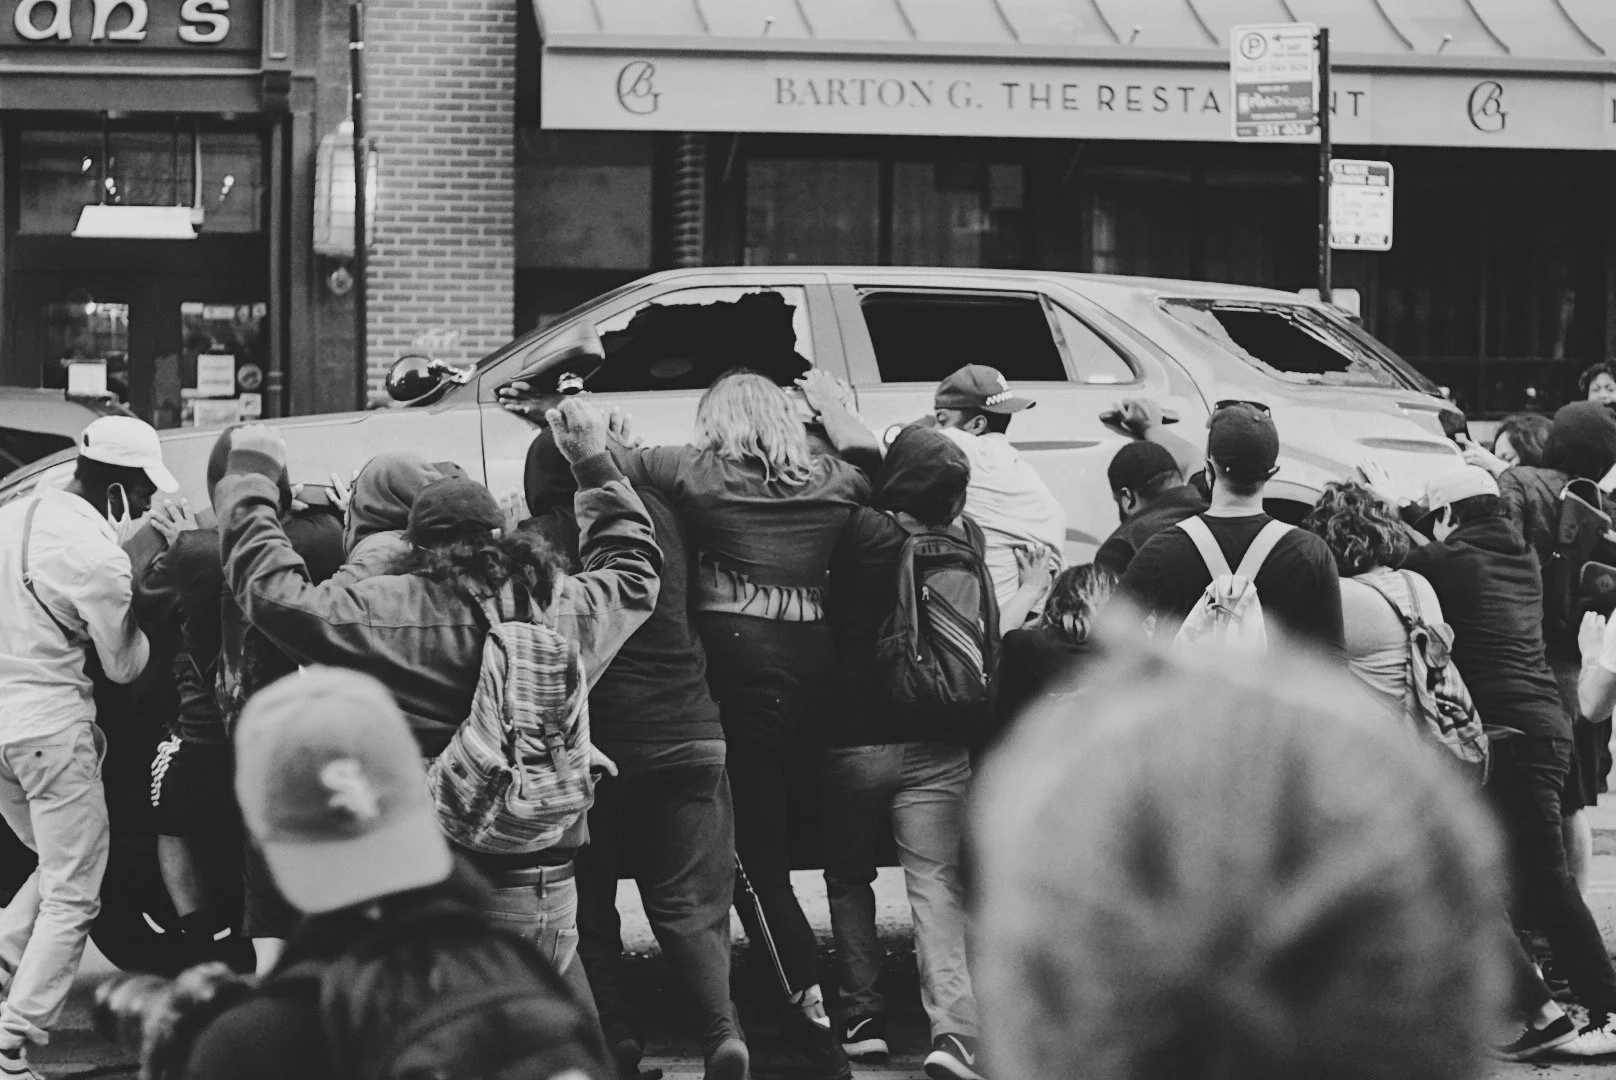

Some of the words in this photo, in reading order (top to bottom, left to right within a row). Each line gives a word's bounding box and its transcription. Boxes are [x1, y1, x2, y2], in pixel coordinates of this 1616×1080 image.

[775, 77, 932, 107] BARTON
[948, 79, 983, 108] G.
[1000, 82, 1079, 110] THE
